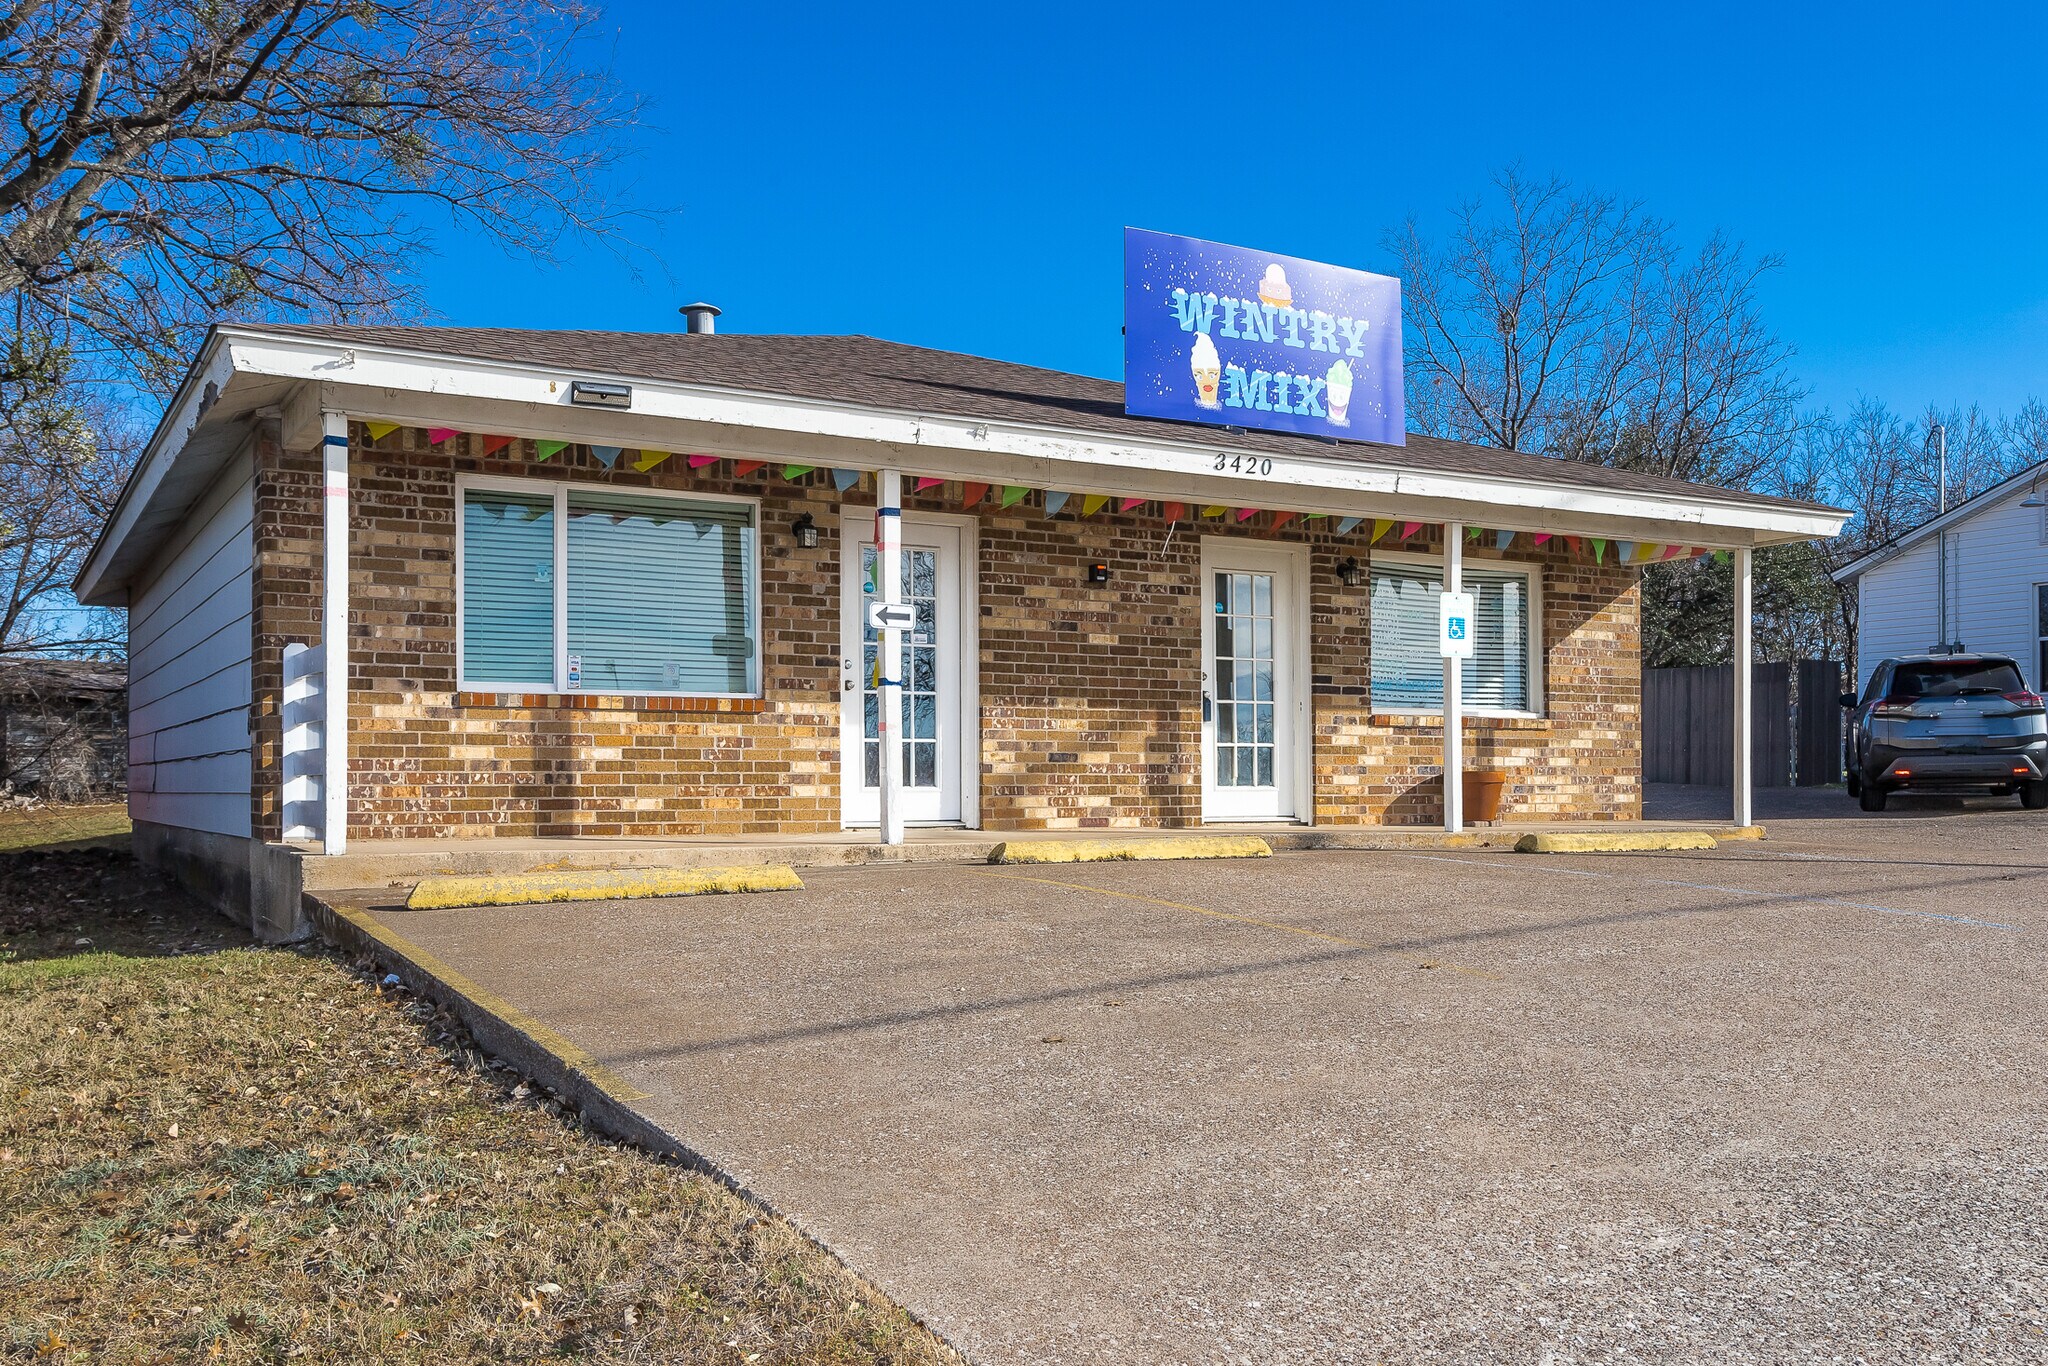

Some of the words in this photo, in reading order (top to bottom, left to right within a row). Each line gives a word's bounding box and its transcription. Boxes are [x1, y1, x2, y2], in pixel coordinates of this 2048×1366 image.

[1169, 288, 1369, 358] WINTRY
[1222, 362, 1327, 418] MIX
[1213, 453, 1272, 475] 3420
